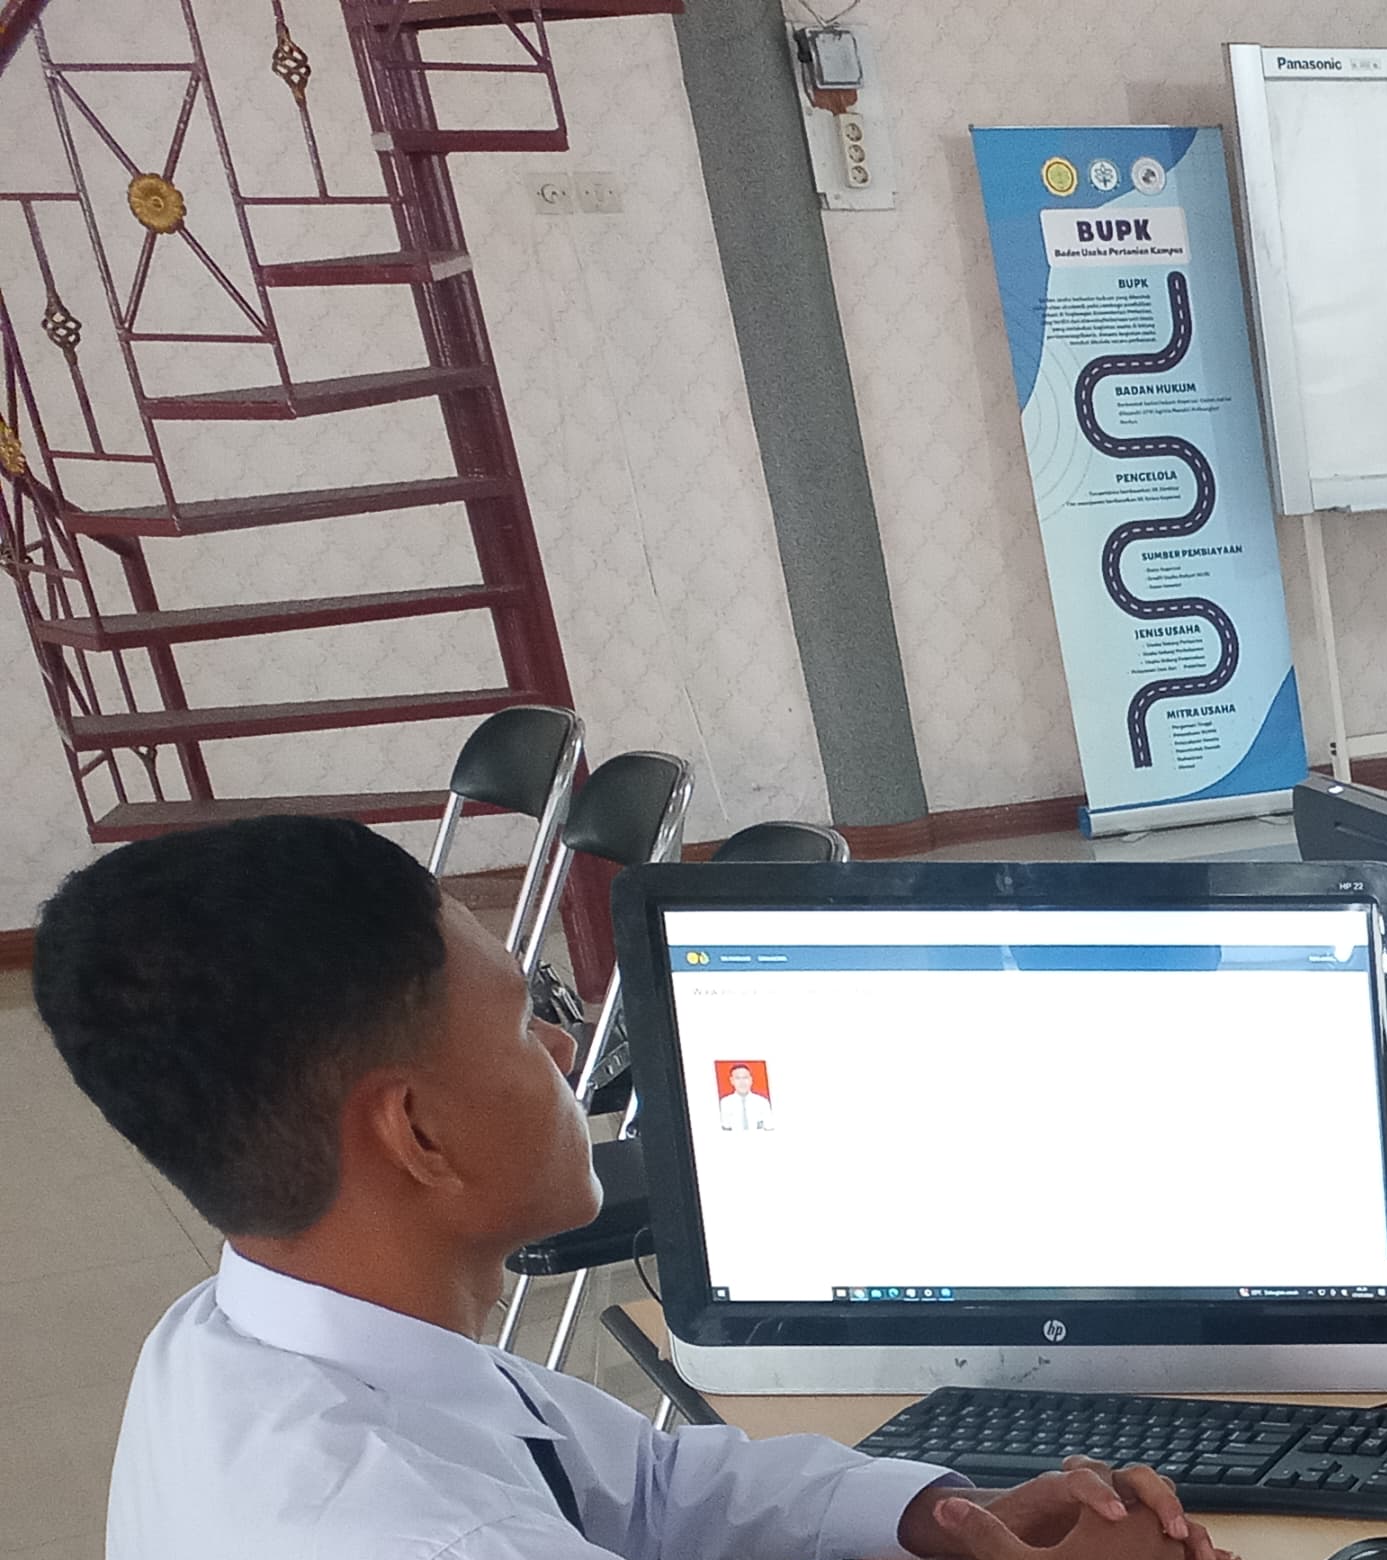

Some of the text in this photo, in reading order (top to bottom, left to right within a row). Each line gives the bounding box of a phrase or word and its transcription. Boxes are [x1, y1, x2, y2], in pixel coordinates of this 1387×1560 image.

[1277, 57, 1342, 70] Panasonic
[1076, 219, 1152, 242] BUPK
[1054, 246, 1183, 257] Badan Usaha Pertanian Kampus
[1118, 279, 1149, 289] BUPK
[1115, 383, 1197, 396] BADAN HUKUM
[1115, 470, 1178, 483] PENGELOLA
[1141, 544, 1243, 561] SUMBER PEMBIAYAAN
[1134, 624, 1201, 640] JENIS USAHA
[1166, 703, 1236, 719] MITRA USAHA
[1044, 1320, 1065, 1341] hp
